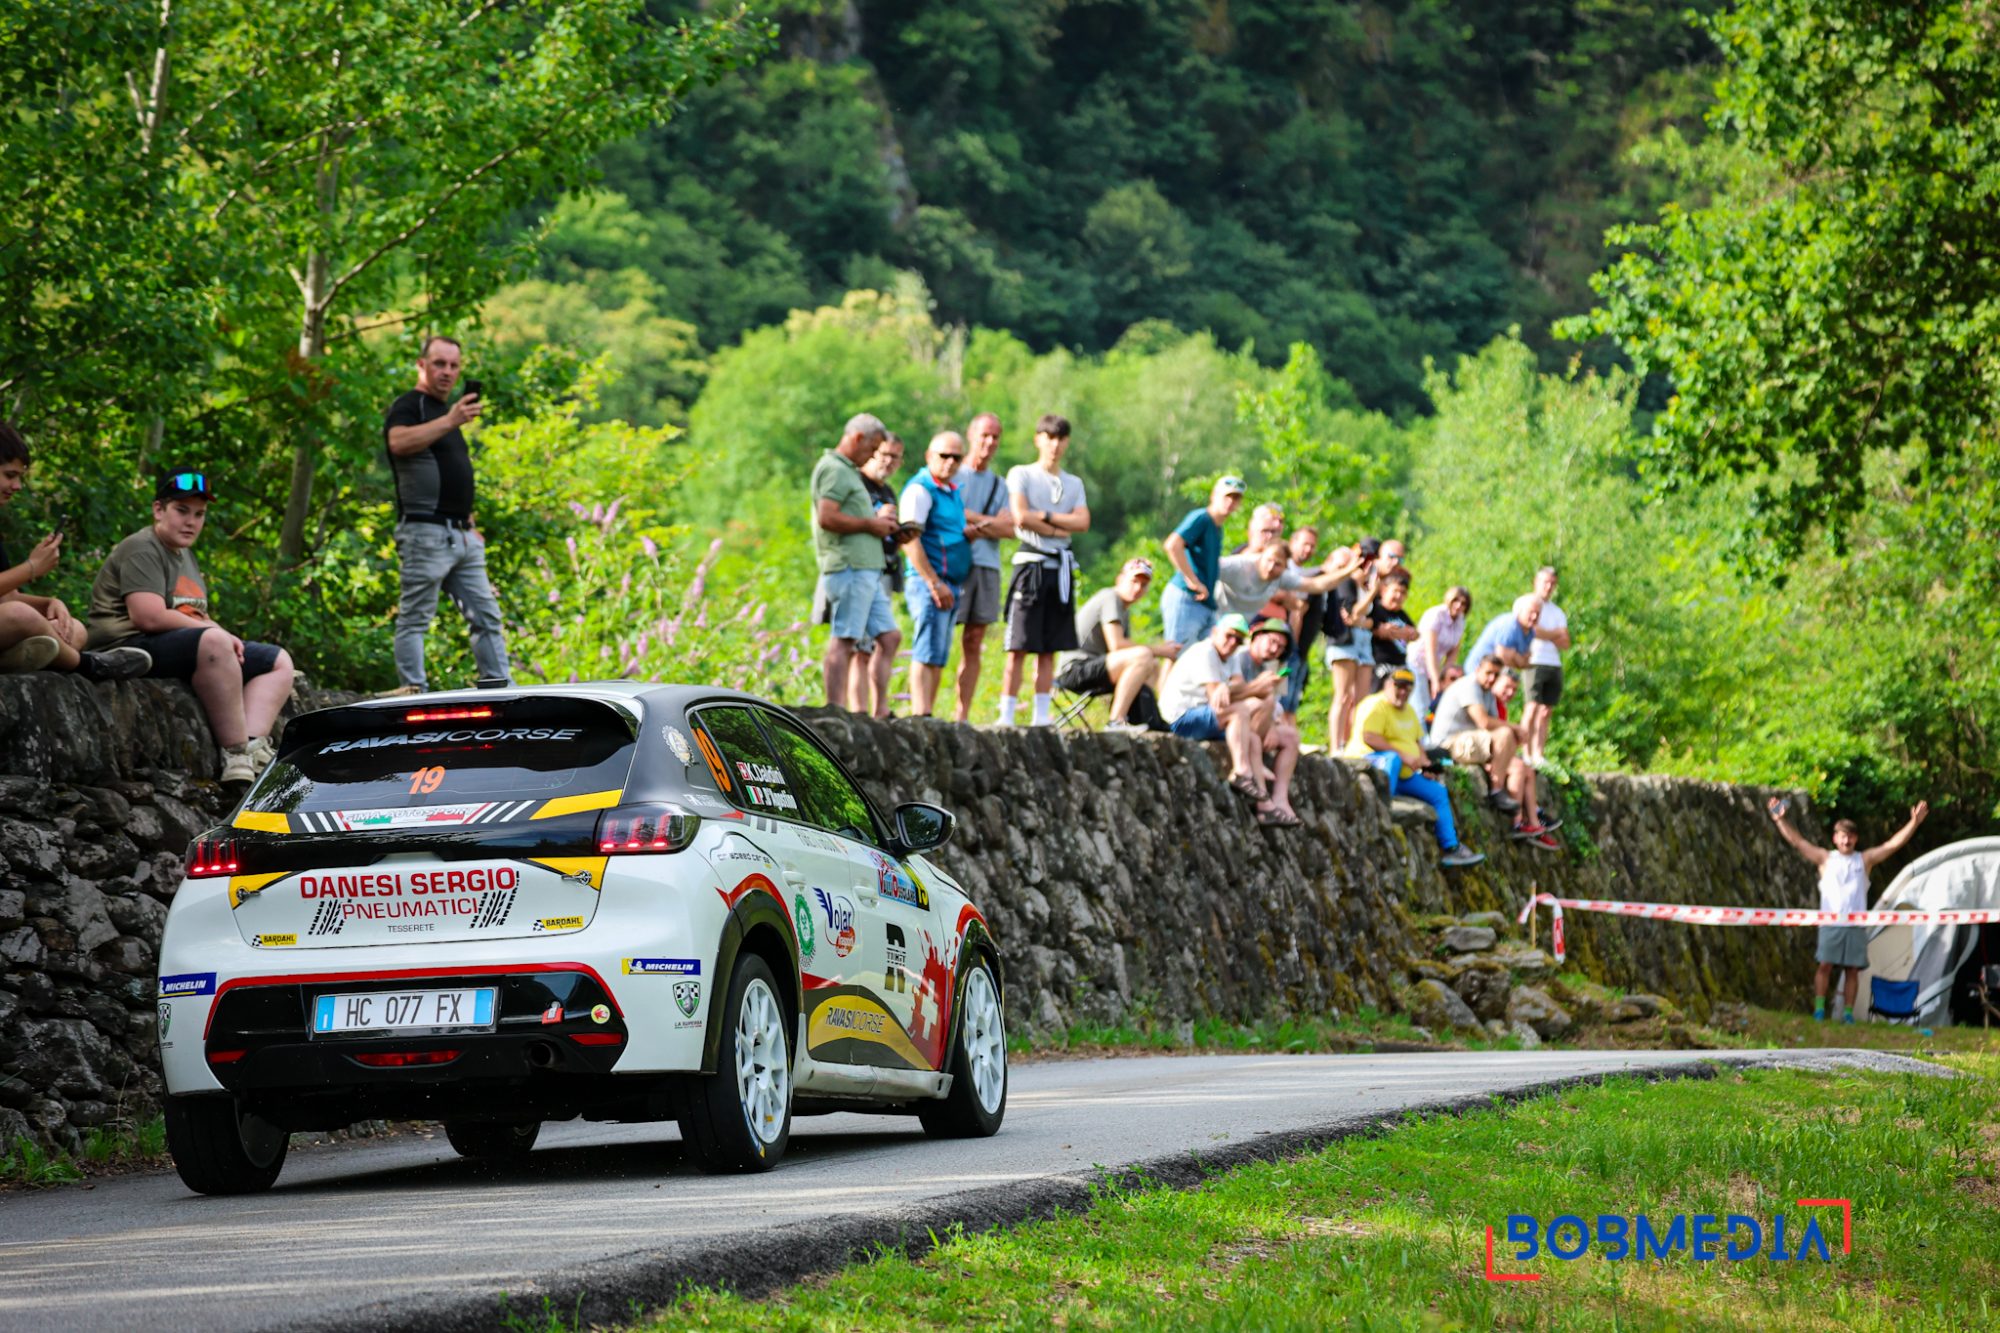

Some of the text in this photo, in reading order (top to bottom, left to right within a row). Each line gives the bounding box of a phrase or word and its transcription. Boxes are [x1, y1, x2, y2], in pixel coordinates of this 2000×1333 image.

[318, 728, 583, 755] RAVASICORSE
[409, 766, 445, 795] 19
[300, 867, 516, 899] DANESI SERGIO
[342, 897, 479, 920] PNEUMATICI
[387, 923, 435, 933] TESSERETE
[546, 917, 581, 928] BARDAHL
[263, 935, 295, 945] BARDAHL
[645, 963, 694, 971] MICHELIN
[165, 980, 206, 992] MICHELIN
[346, 993, 462, 1026] HC 077 FX
[825, 1006, 887, 1033] RAVASICORSE
